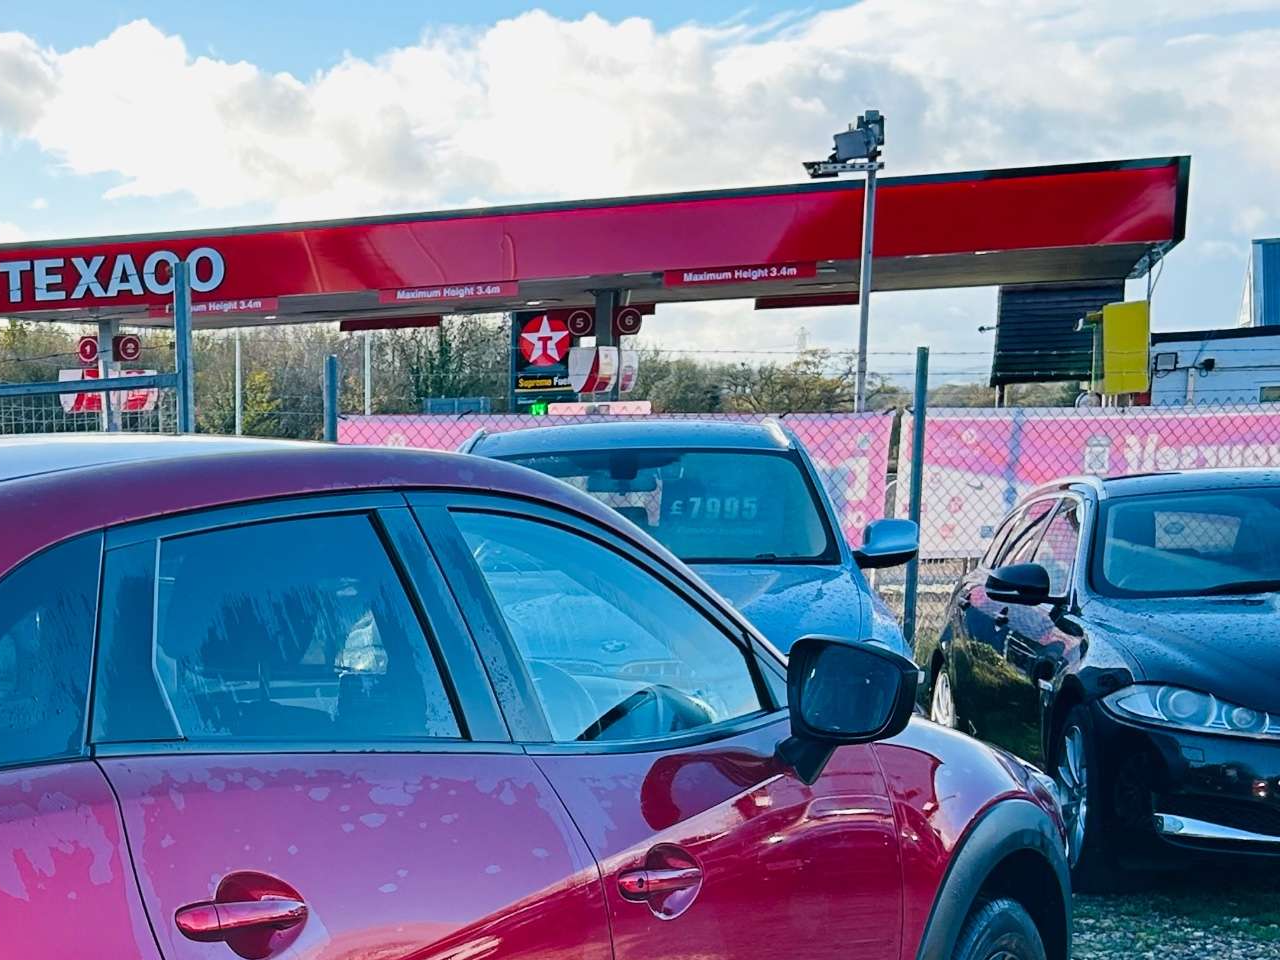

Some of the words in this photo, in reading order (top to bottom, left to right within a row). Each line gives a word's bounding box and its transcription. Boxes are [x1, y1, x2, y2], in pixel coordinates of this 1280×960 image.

[683, 271, 732, 282] Maximum
[734, 268, 768, 280] Height
[770, 266, 797, 277] 3.4m
[397, 288, 441, 299] Maximum
[443, 286, 474, 298] Height
[476, 285, 500, 295] 3.4m
[208, 301, 237, 312] Height
[239, 300, 262, 309] 3.4m
[575, 317, 585, 328] 5
[624, 315, 634, 326] 6
[84, 344, 91, 355] 1
